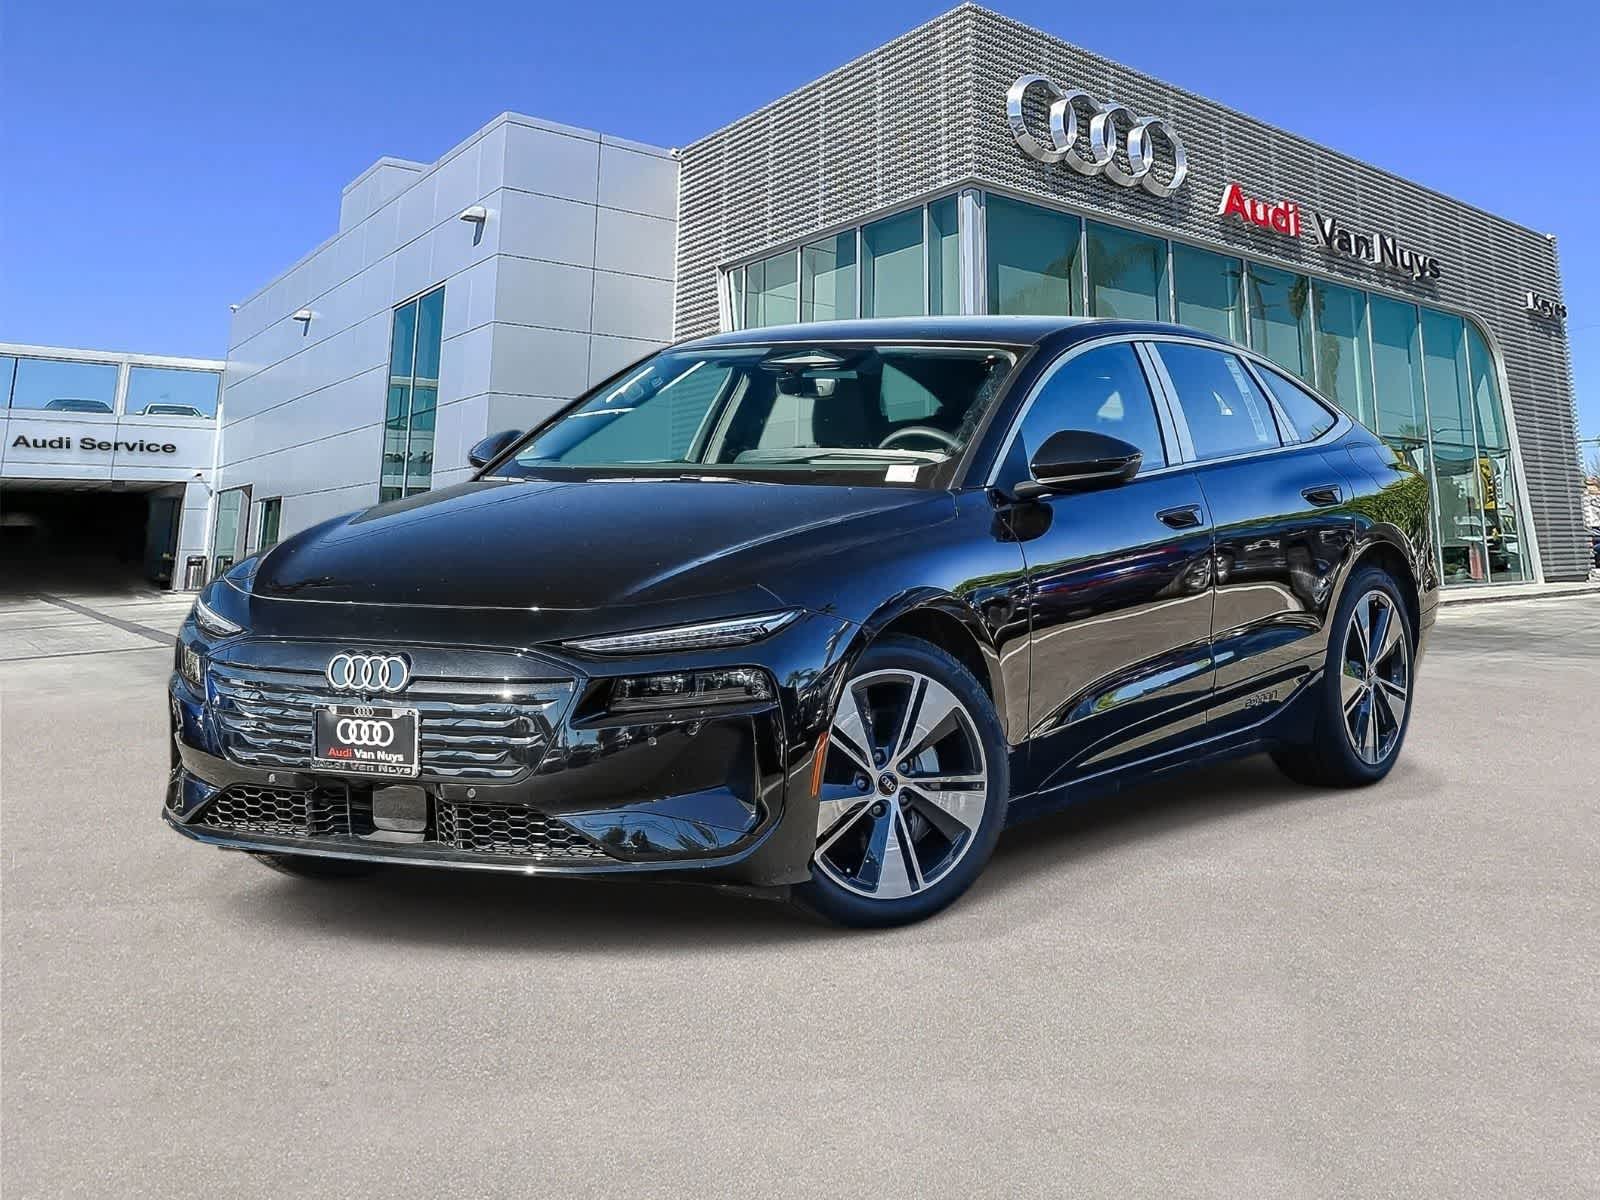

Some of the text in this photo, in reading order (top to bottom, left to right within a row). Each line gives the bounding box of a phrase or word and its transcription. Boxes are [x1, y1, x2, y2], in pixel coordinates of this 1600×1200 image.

[1218, 182, 1442, 281] Audi Van Nuys
[12, 434, 177, 454] Audi Service
[328, 747, 404, 763] Audi Van Nuys
